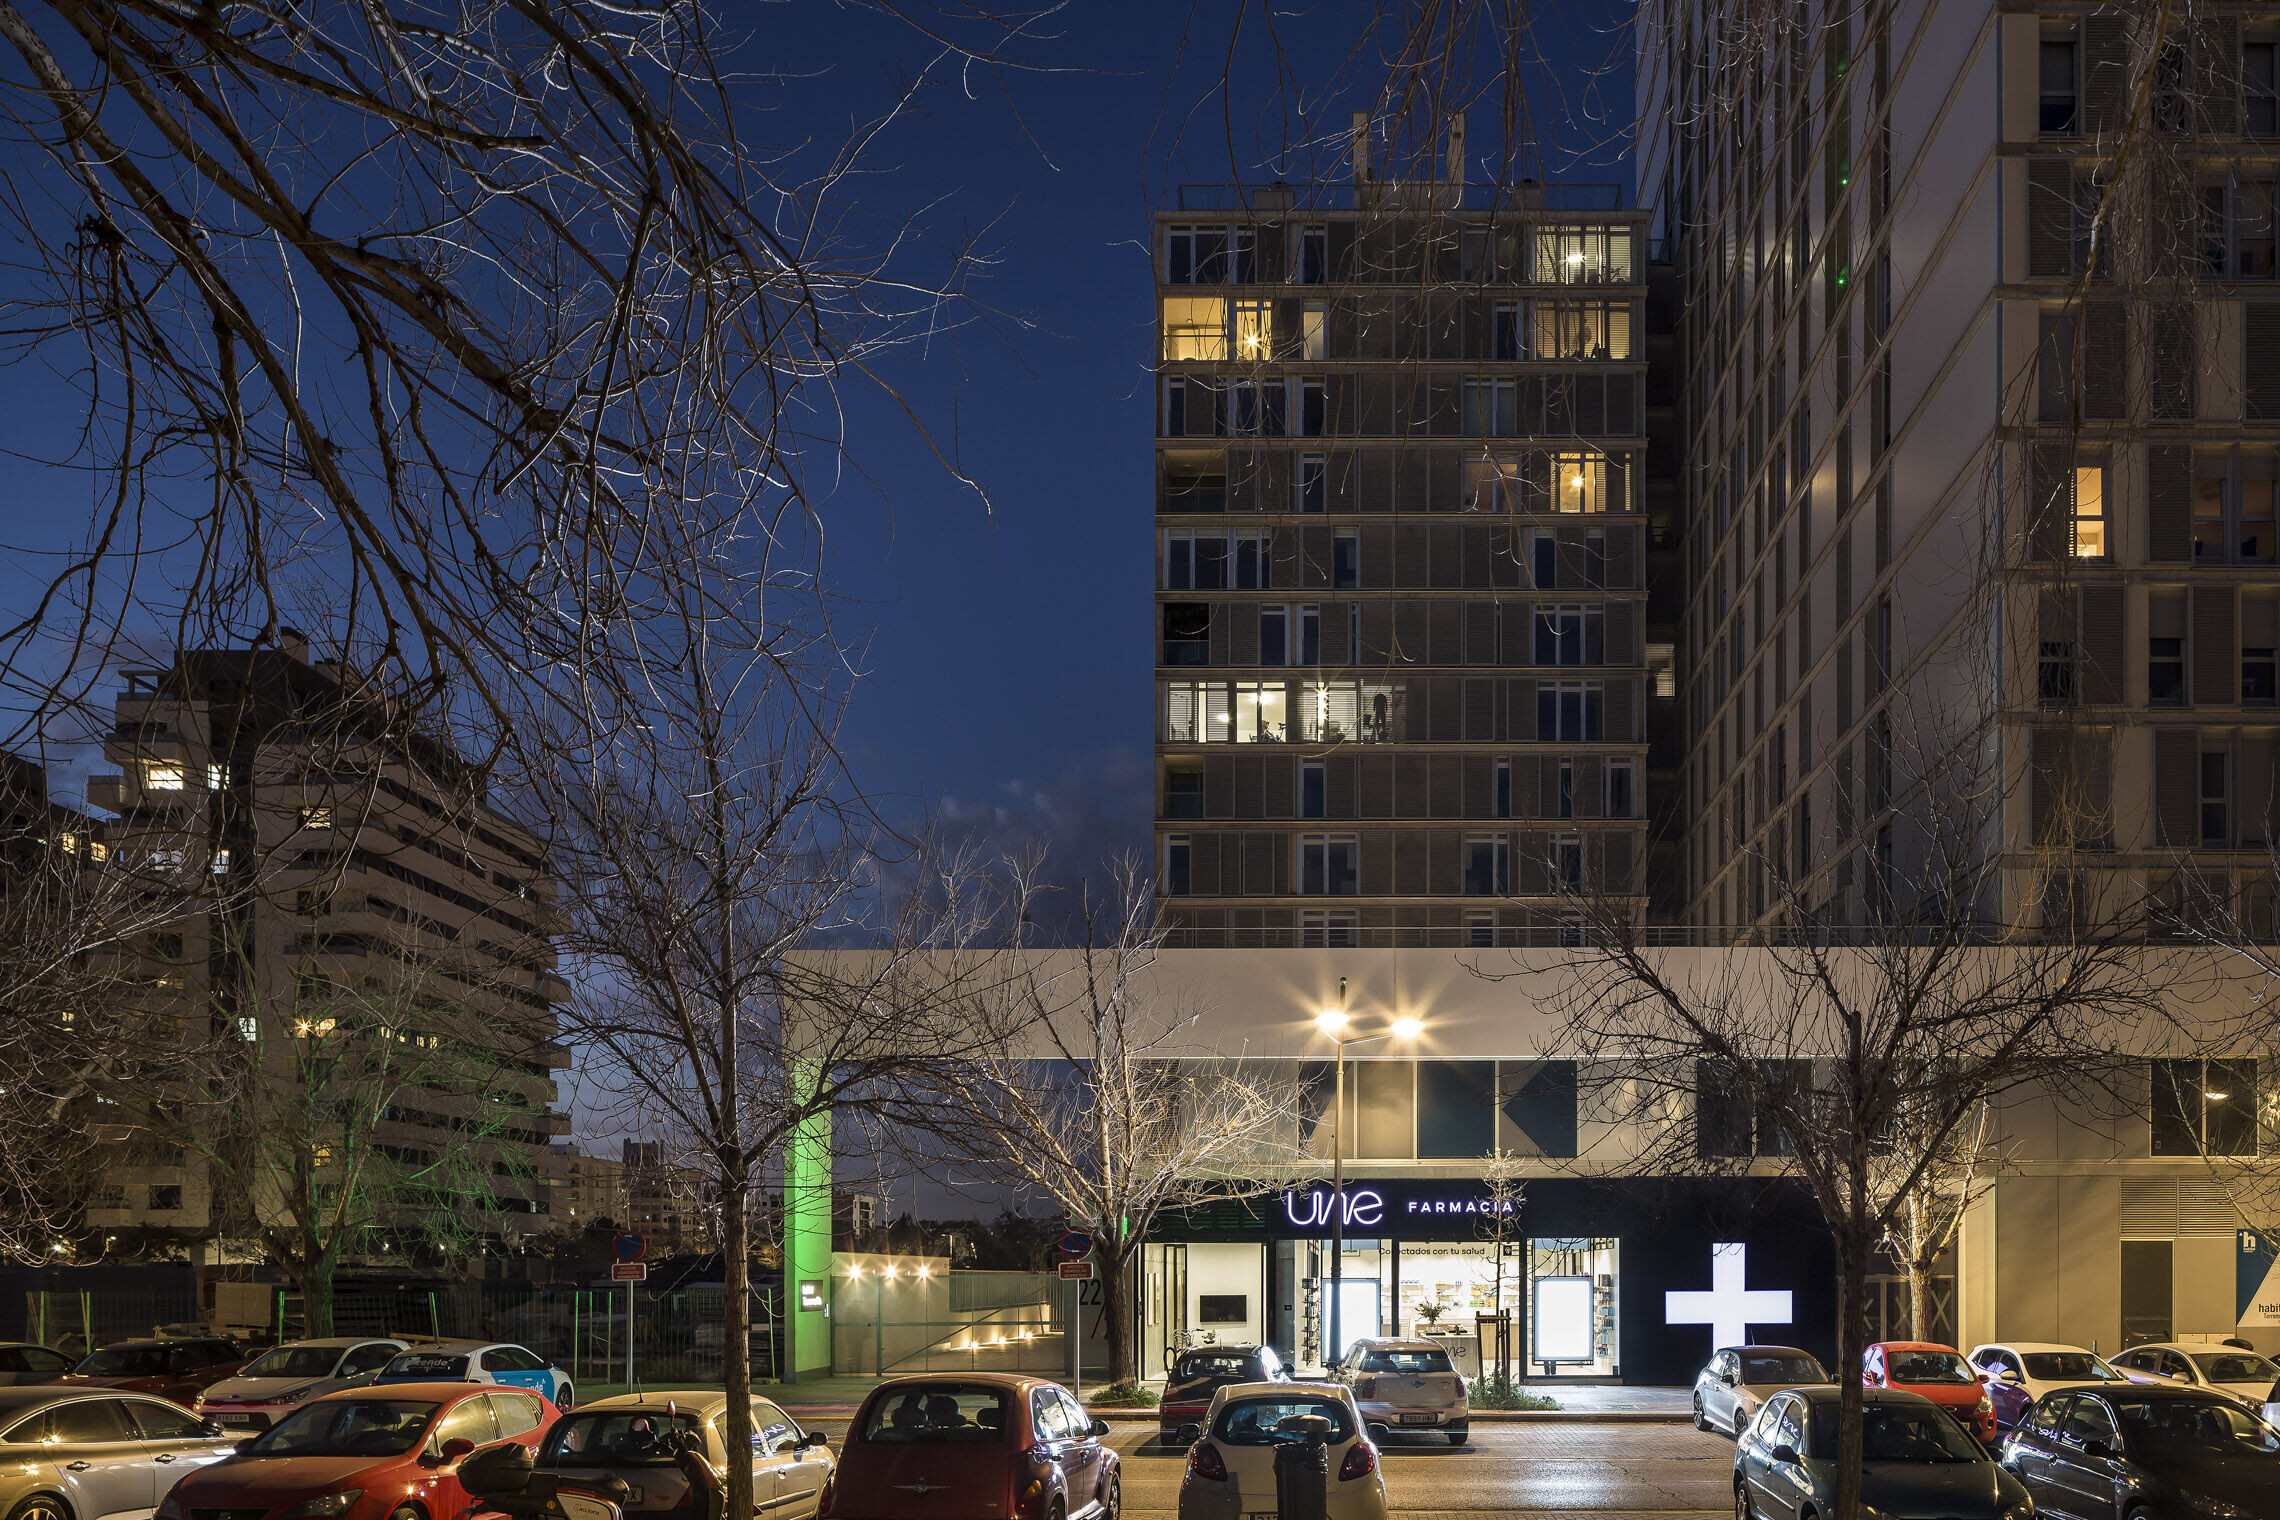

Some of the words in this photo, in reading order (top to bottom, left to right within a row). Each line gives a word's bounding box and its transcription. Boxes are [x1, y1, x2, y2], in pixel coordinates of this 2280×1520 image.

[1408, 1201, 1513, 1213] FARMACIA
[1379, 1247, 1431, 1255] Coectados
[1450, 1247, 1460, 1255] tu
[1461, 1247, 1485, 1255] salud
[1445, 1345, 1467, 1358] ne
